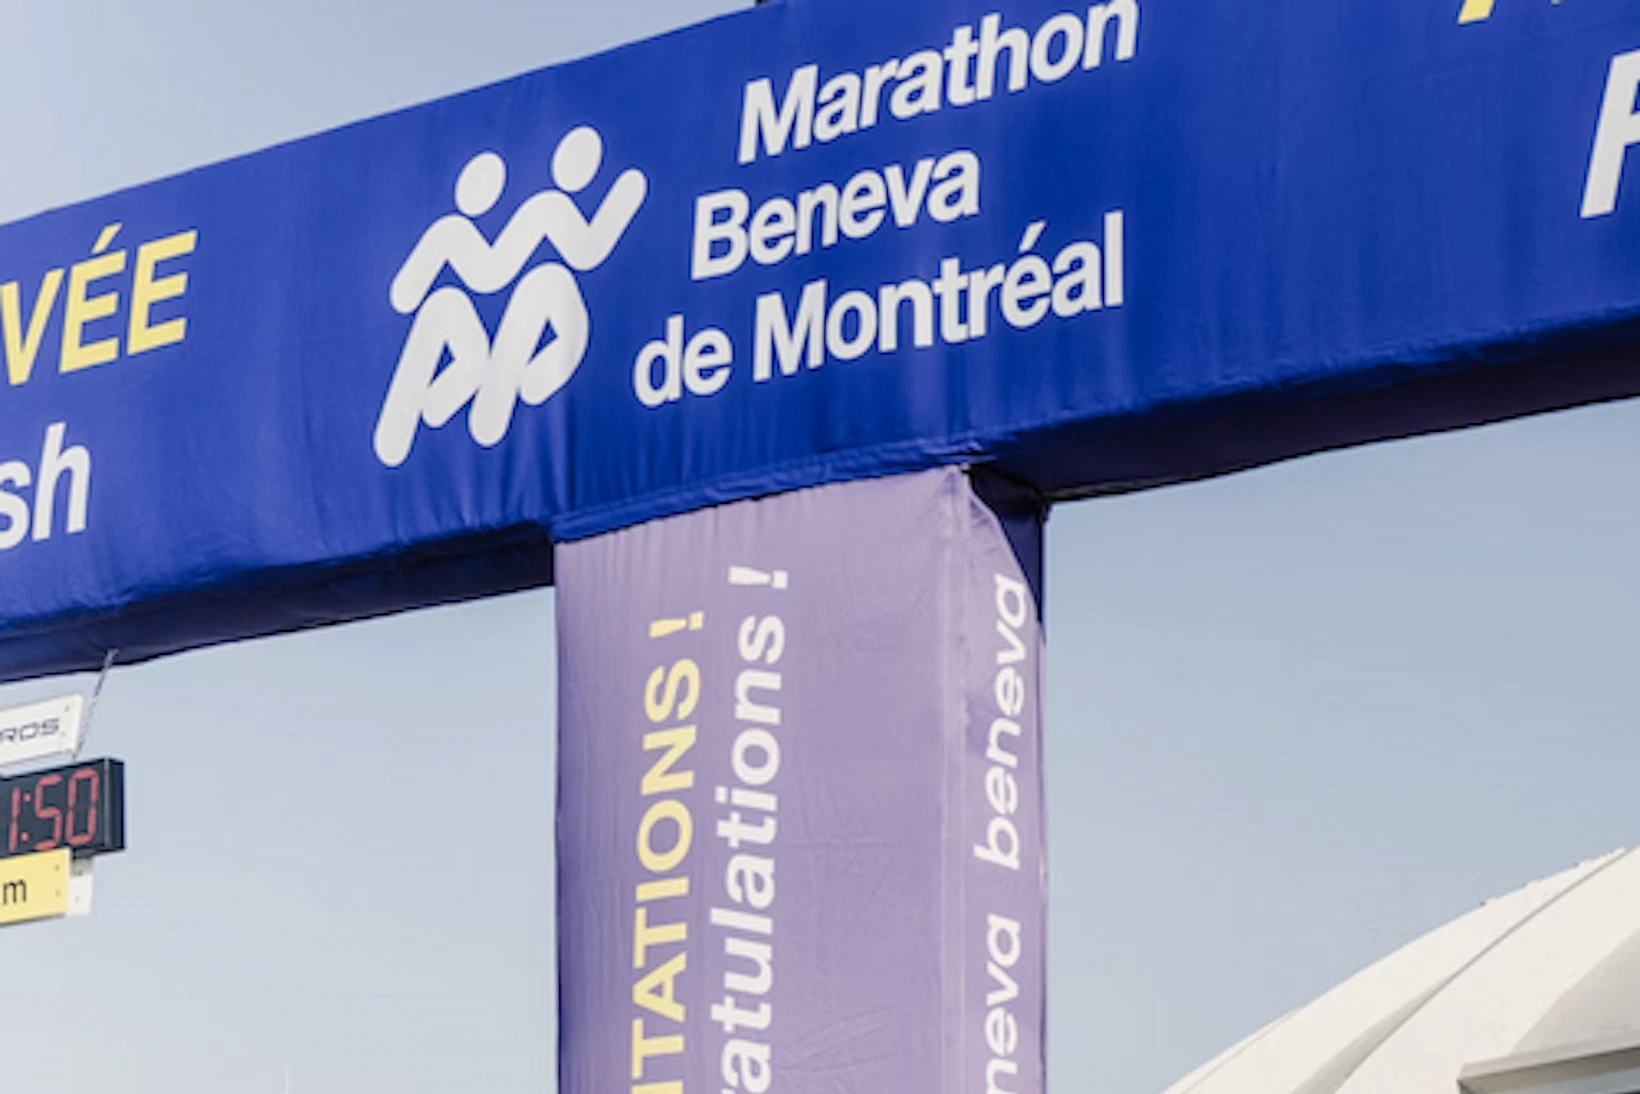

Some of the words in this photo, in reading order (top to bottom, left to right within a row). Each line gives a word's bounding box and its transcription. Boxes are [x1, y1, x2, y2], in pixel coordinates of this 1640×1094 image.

[738, 0, 1138, 163] Marathon
[691, 149, 980, 281] Beneva
[0, 222, 197, 386] VÉE
[634, 315, 732, 406] de
[752, 210, 1124, 383] Montréal
[0, 422, 91, 550] sh
[973, 573, 1027, 870] beneva
